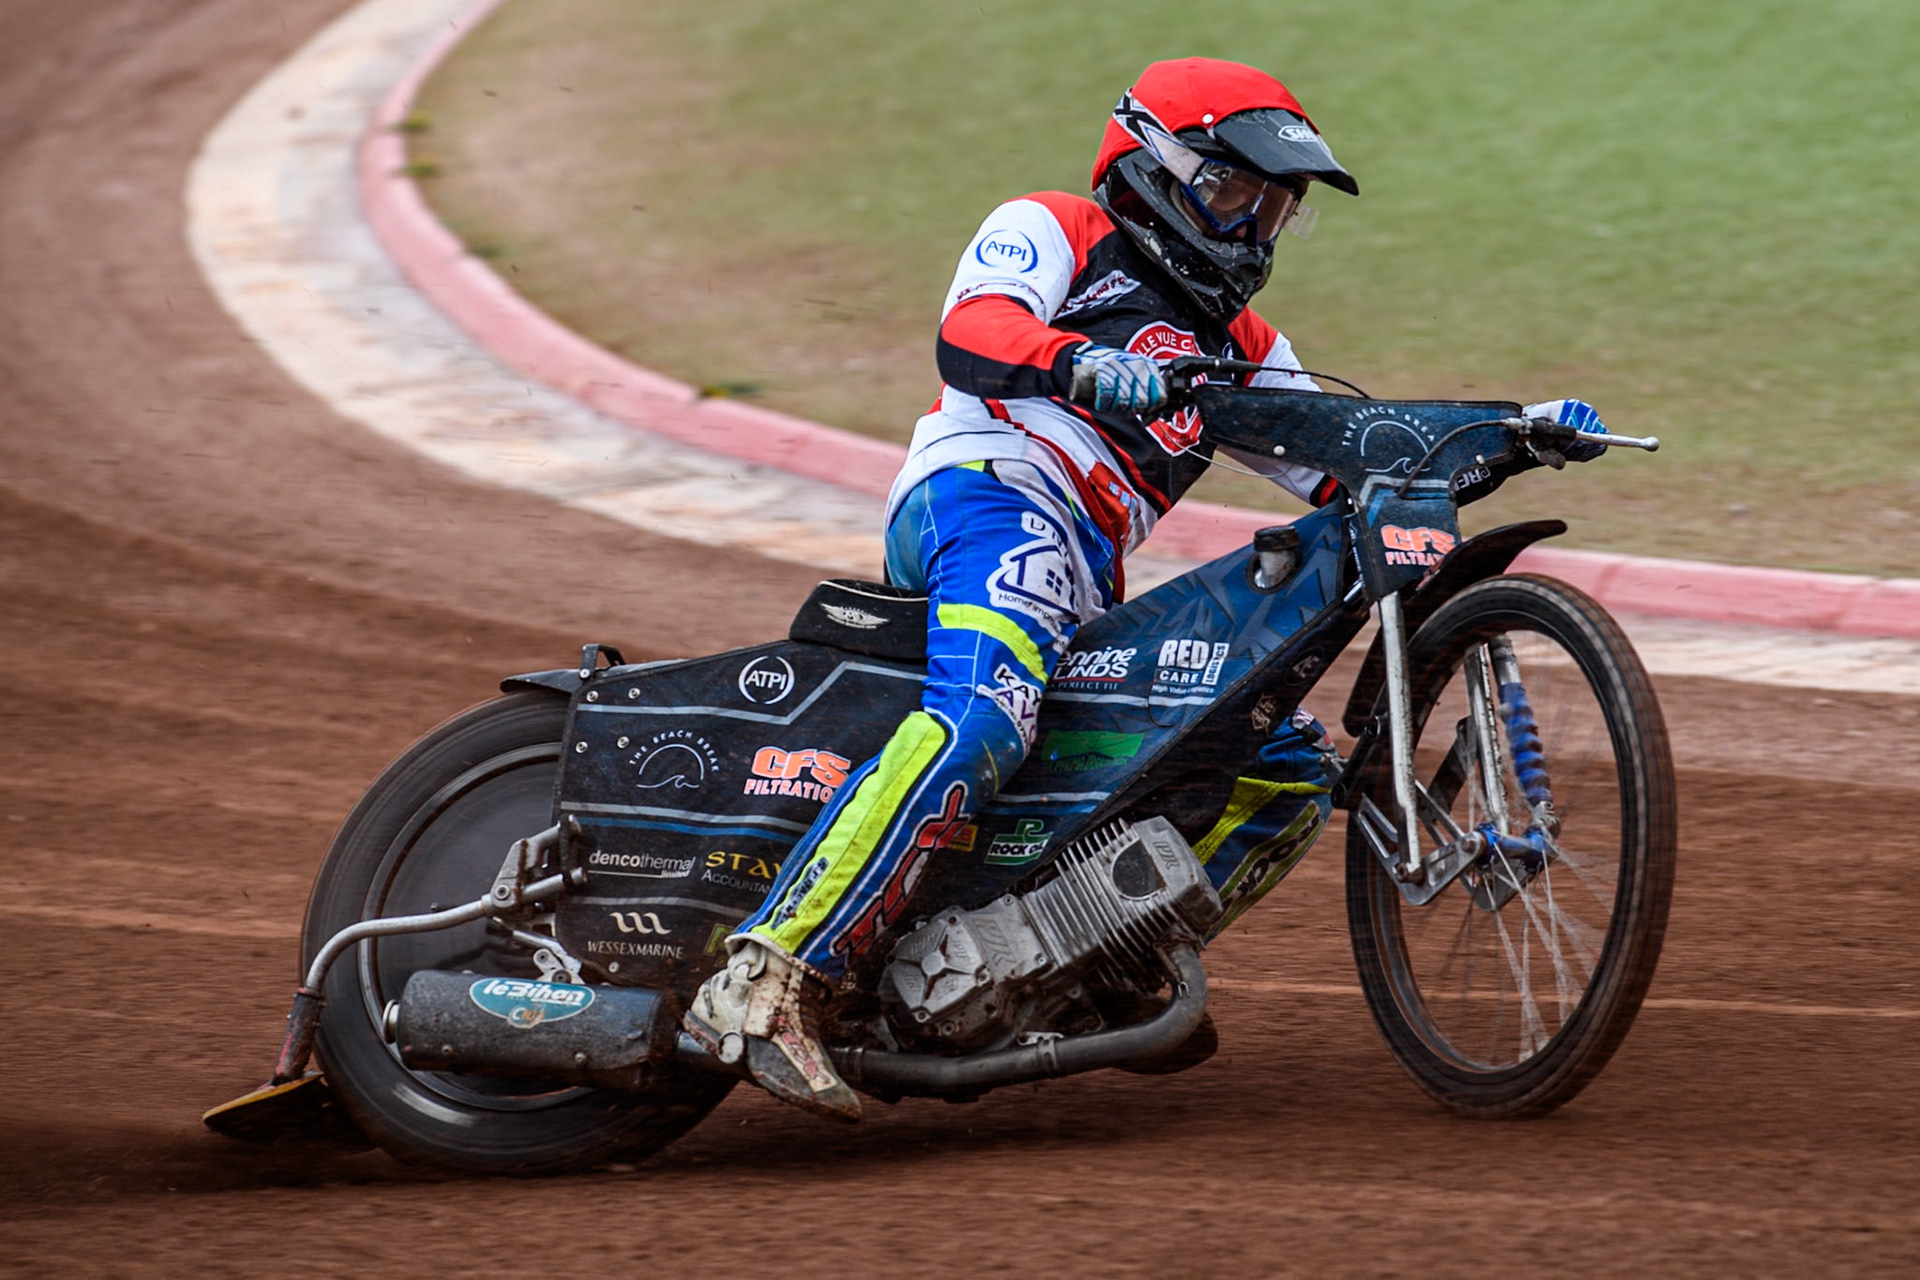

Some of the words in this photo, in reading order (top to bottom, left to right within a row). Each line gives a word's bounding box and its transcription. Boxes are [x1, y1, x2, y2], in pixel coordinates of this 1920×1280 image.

[986, 240, 1028, 262] ATPI
[1155, 331, 1177, 347] VUE
[1342, 421, 1357, 446] THE
[1355, 406, 1396, 420] BEACH
[1404, 413, 1435, 442] BREA
[1380, 524, 1457, 555] CFS
[1056, 645, 1138, 666] ennine
[1157, 639, 1210, 670] RED
[744, 669, 787, 690] ATPI
[1053, 661, 1129, 680] LINDS
[1159, 670, 1199, 684] CARE
[1000, 667, 1041, 706] KAY
[628, 745, 648, 766] THE
[652, 729, 693, 744] BEACH
[696, 737, 720, 772] BREAK
[751, 746, 852, 789] CFS
[743, 778, 834, 804] FILTRATIO
[588, 849, 697, 871] dencothermal
[990, 843, 1029, 855] ROCK
